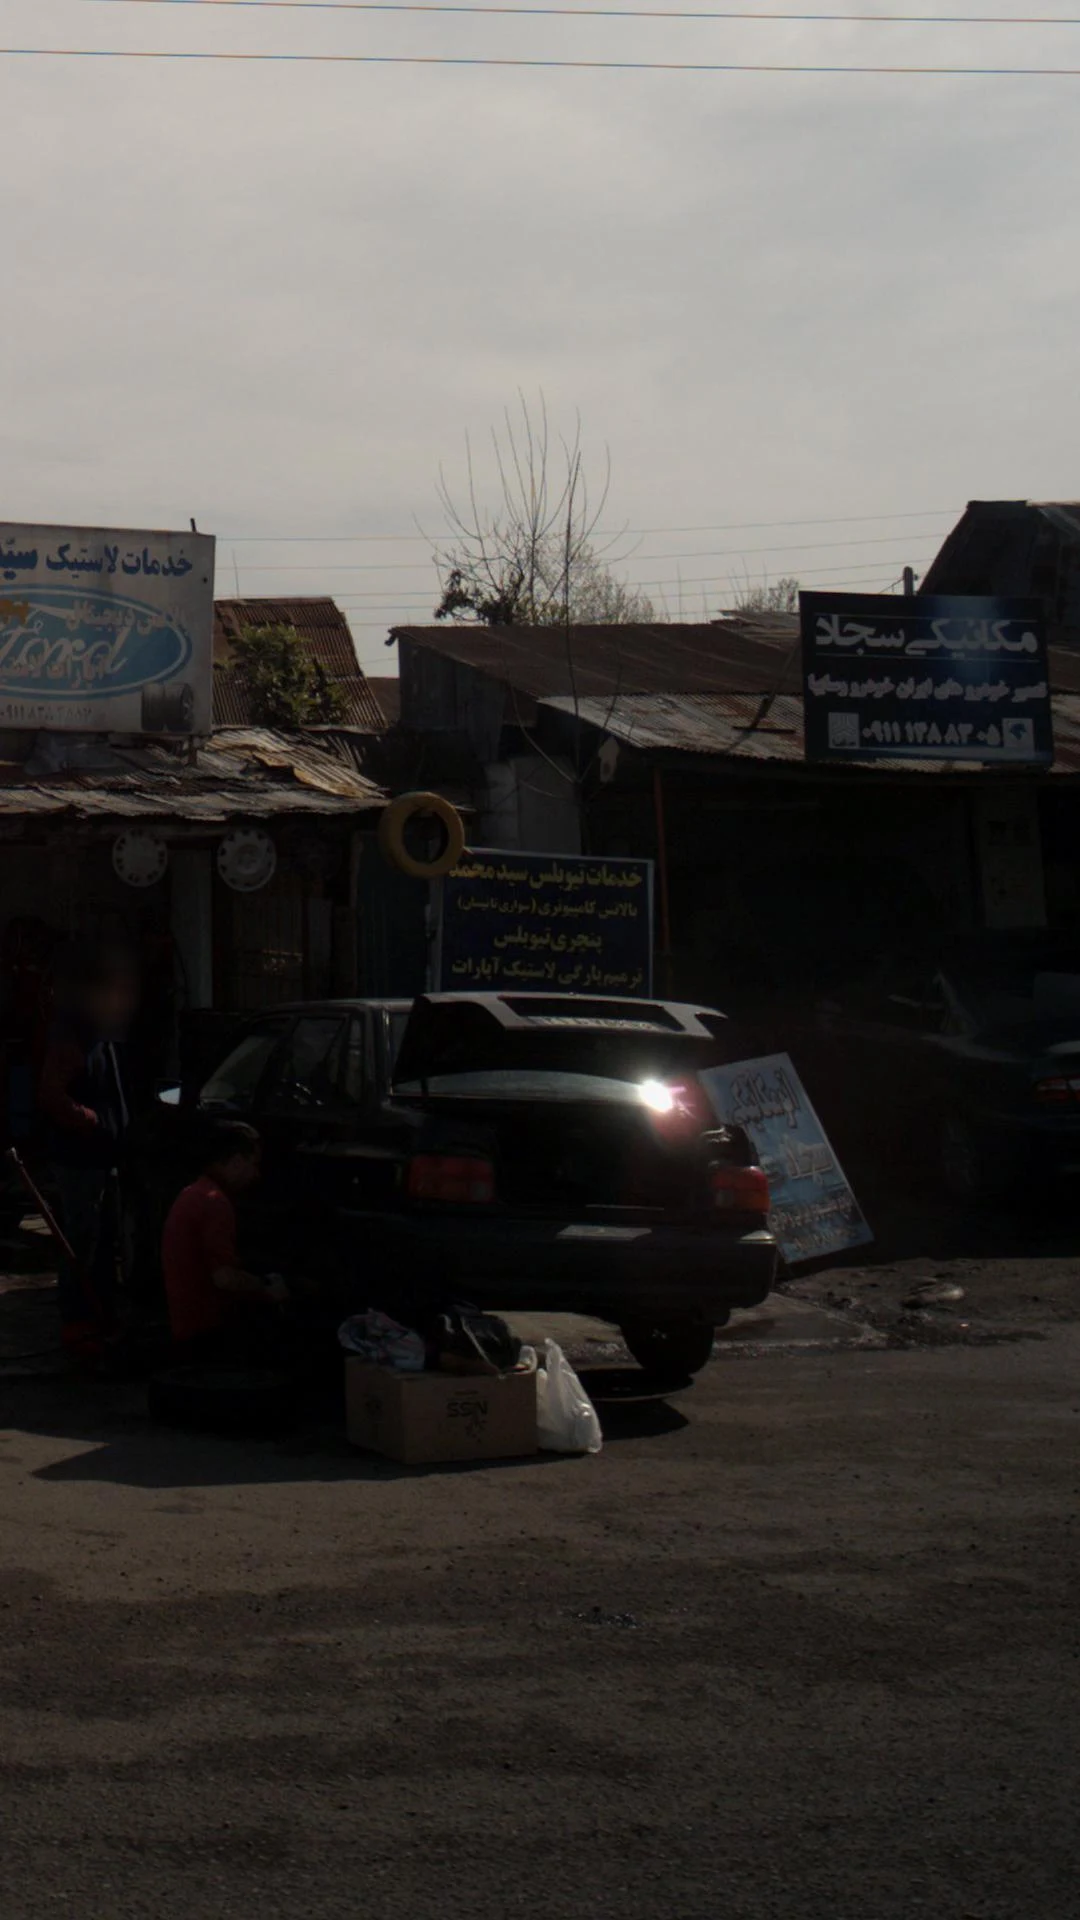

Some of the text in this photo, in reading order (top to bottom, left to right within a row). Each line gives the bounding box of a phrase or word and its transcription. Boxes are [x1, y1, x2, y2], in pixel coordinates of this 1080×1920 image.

[46, 543, 120, 578] لاستیک
[121, 547, 193, 576] خدمات
[815, 614, 1038, 659] مکانیکی سجاد
[496, 863, 529, 887] سید
[529, 861, 586, 892] تیوبلس
[587, 863, 643, 888] خدمات
[538, 899, 597, 918] کامپیوتری
[598, 901, 638, 919] بالانس
[493, 925, 603, 954] پنچری تیوبلس
[451, 956, 502, 981] آپارات
[501, 959, 557, 982] لاستیک
[603, 967, 643, 988] ترمیم
